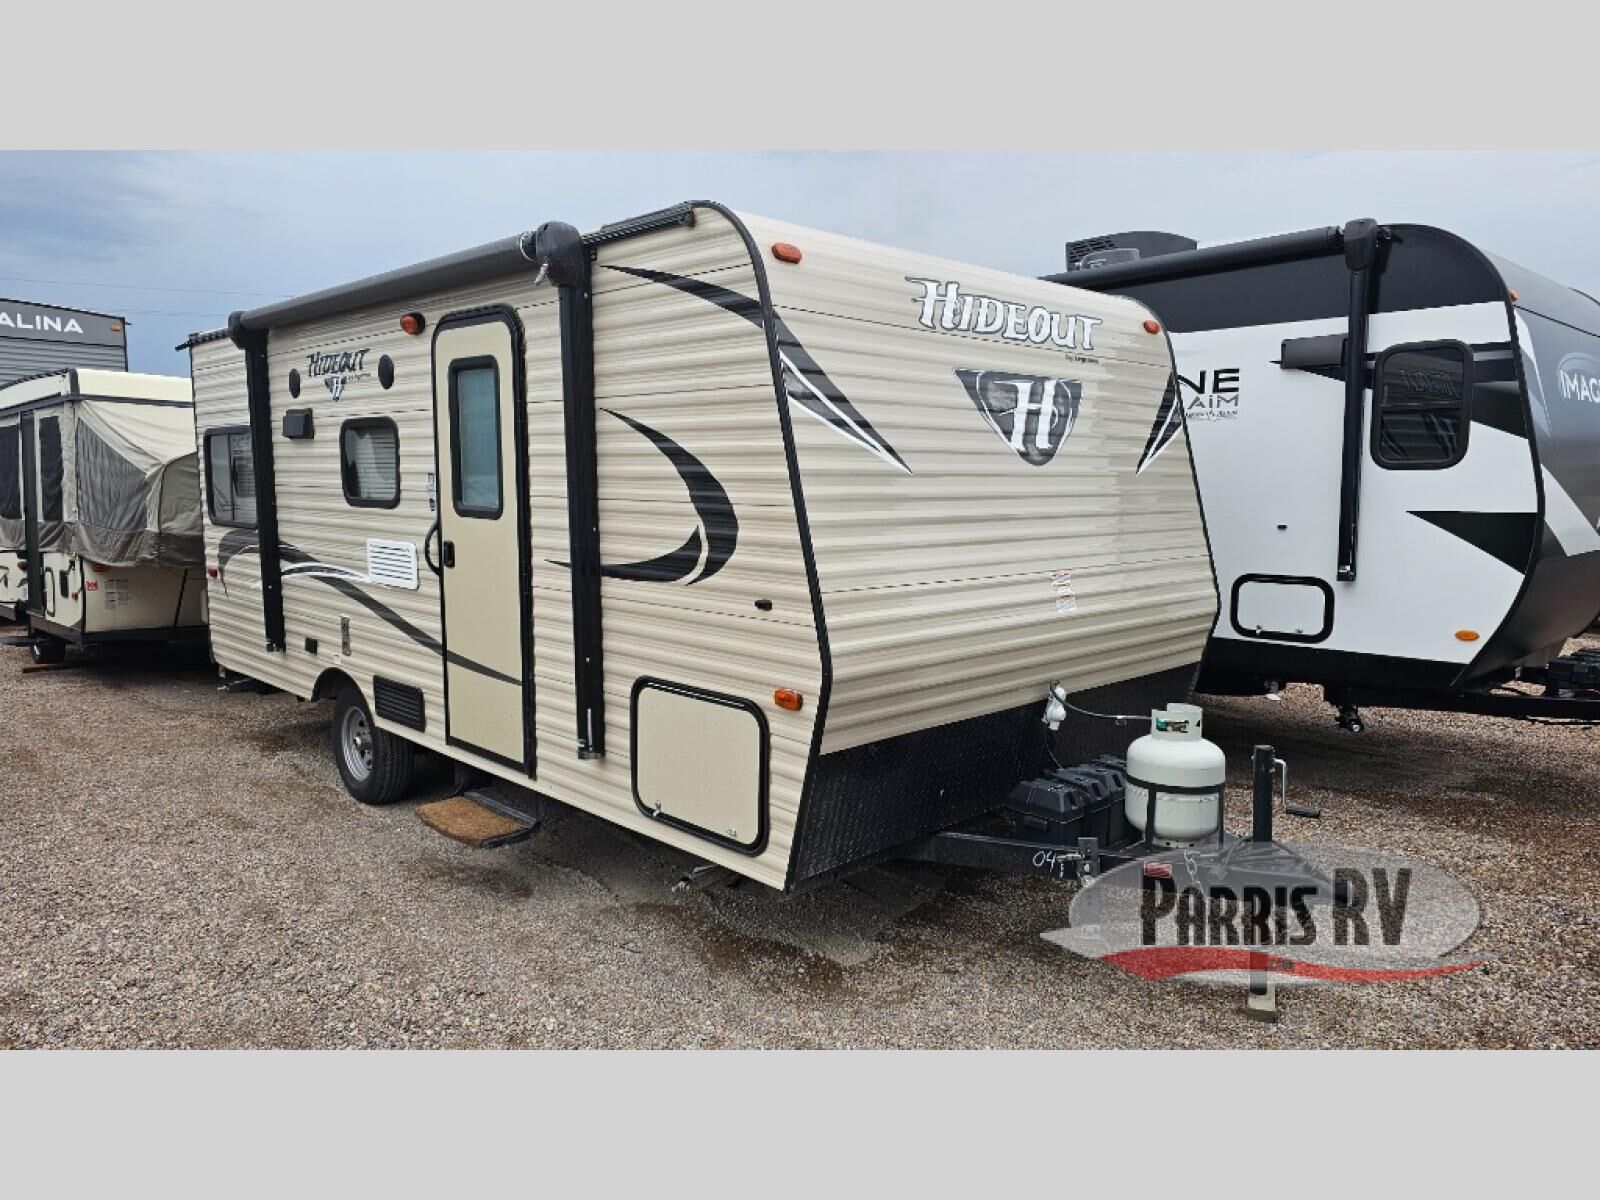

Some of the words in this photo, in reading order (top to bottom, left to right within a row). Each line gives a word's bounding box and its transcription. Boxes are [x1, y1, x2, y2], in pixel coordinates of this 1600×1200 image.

[905, 276, 1103, 350] HIDEOUT
[306, 348, 370, 377] HIDEOUT
[993, 379, 1059, 451] H
